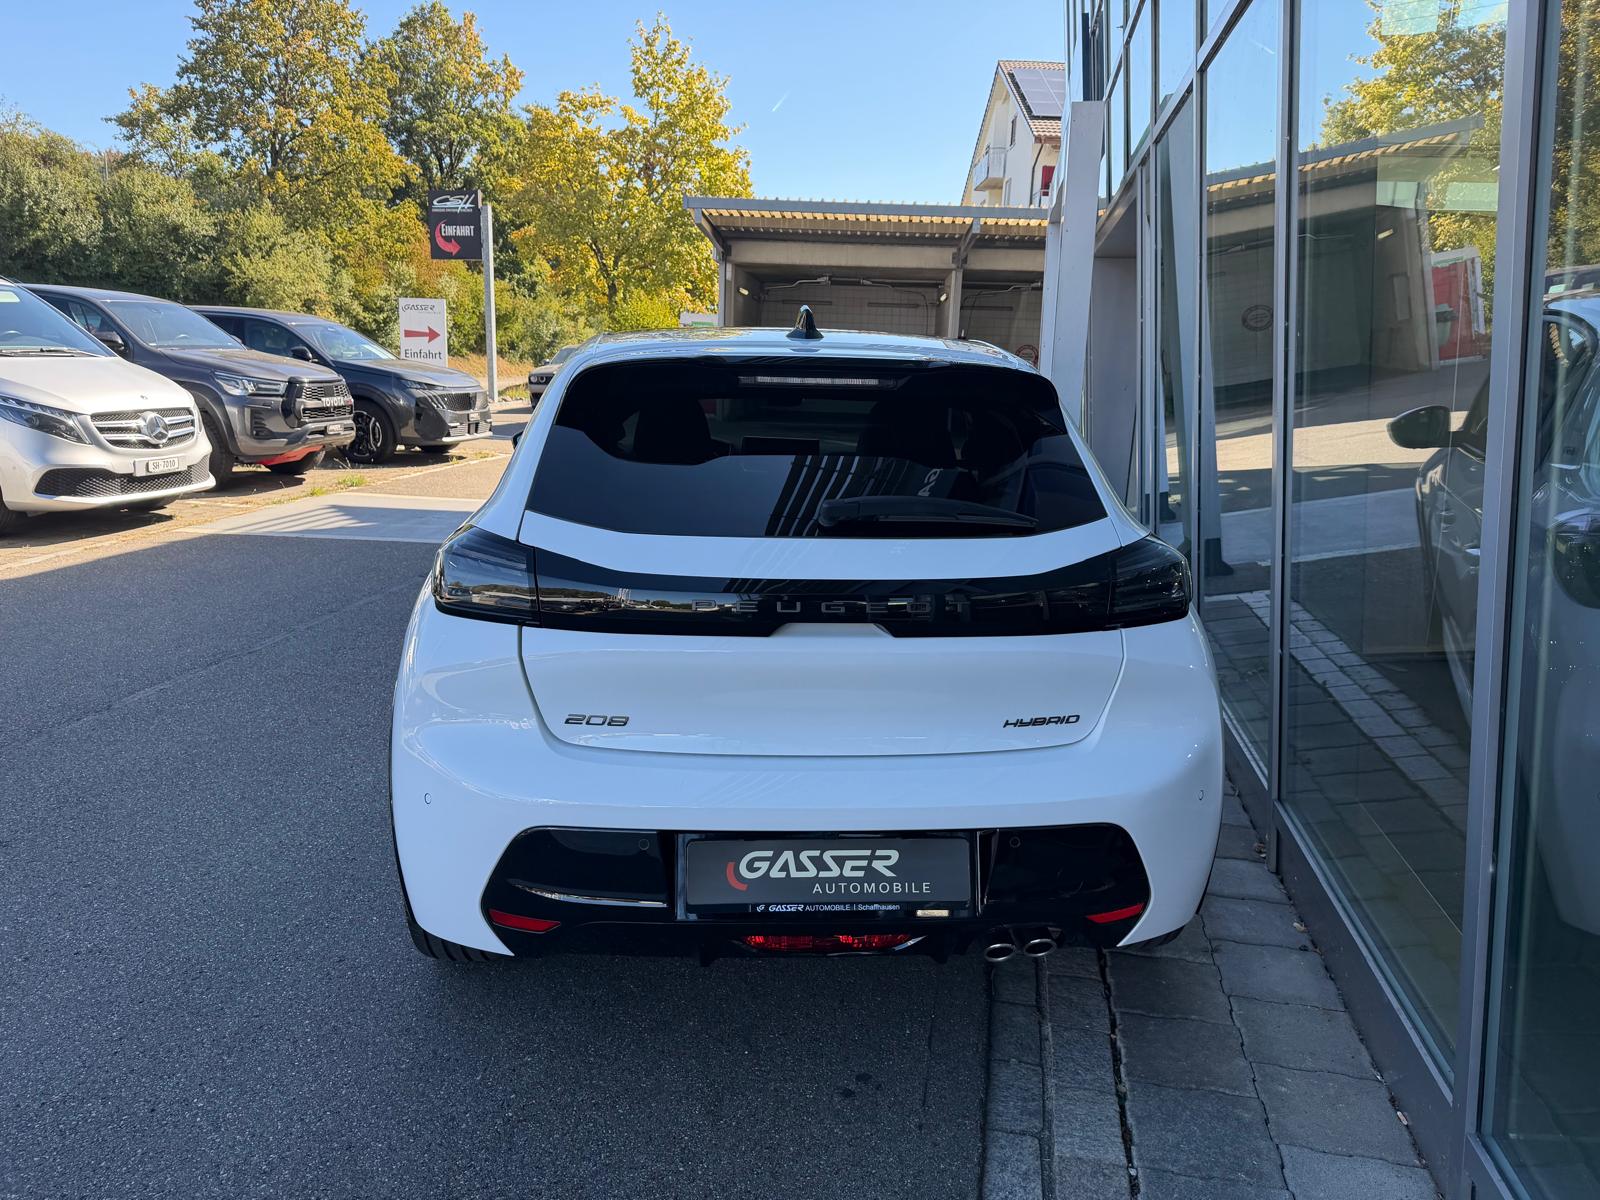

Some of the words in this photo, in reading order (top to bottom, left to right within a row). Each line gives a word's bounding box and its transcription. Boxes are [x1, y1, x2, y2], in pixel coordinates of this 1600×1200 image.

[404, 349, 442, 359] Einfahrt
[321, 397, 345, 407] TOYOTA
[691, 600, 970, 613] PEUGEOT
[564, 714, 630, 727] 208
[1003, 714, 1081, 728] HYBRID
[738, 850, 900, 879] GASSER
[812, 882, 932, 894] AUTOMOBILE
[768, 904, 804, 912] GASSER
[857, 903, 901, 911] Schaffhausen
